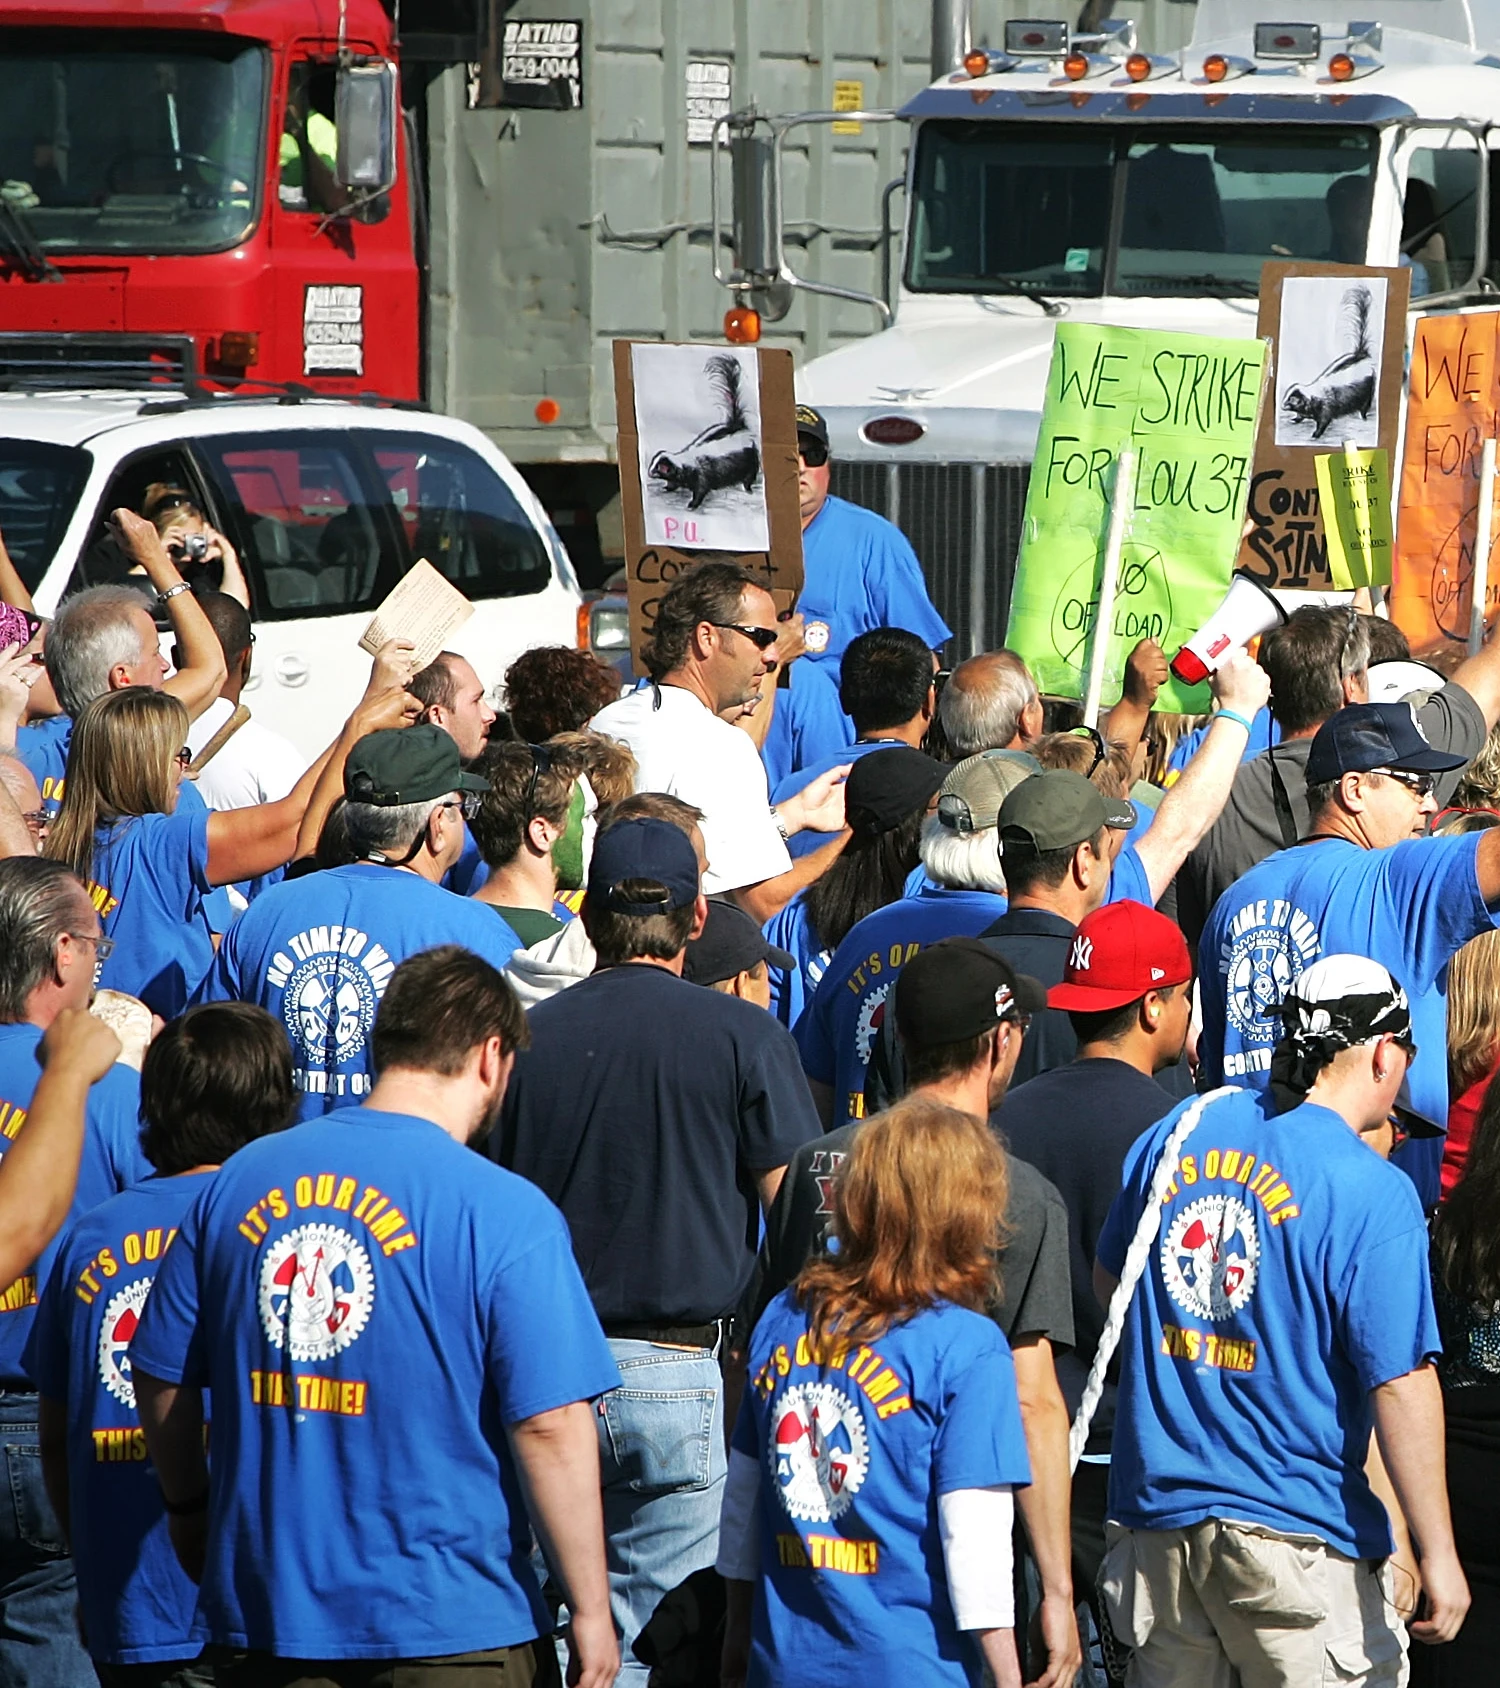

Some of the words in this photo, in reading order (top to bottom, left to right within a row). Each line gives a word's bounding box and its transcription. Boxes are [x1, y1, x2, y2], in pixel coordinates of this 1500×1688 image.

[1422, 327, 1485, 402] WE
[1060, 341, 1128, 409] WE
[1140, 350, 1261, 433] STRIKE
[1423, 424, 1482, 484] FOR
[1045, 436, 1111, 505] FOR
[1133, 447, 1200, 512] LOU
[1204, 453, 1248, 521] 37
[1247, 469, 1321, 527] CONT
[664, 517, 705, 543] P.U.
[1241, 527, 1333, 589] STIN
[1062, 598, 1098, 634] OF
[1113, 611, 1163, 640] LOAD
[86, 880, 118, 919] IME
[1070, 935, 1094, 970] NY
[1228, 900, 1267, 940] TIME
[1270, 900, 1291, 928] TO
[1289, 907, 1322, 961] WAIT
[267, 951, 295, 989] NO
[287, 925, 342, 962] TIME
[341, 927, 368, 958] TO
[361, 943, 396, 999] WAI
[847, 951, 882, 995] IT'S
[1223, 1047, 1272, 1077] CONTR
[1204, 1148, 1257, 1185] OUR
[1250, 1162, 1299, 1226] TIME
[237, 1187, 291, 1246] IT'S
[294, 1173, 358, 1212] OUR
[352, 1185, 418, 1257] TIME
[75, 1247, 118, 1305] IT'S
[123, 1229, 176, 1265] OU
[1226, 1270, 1239, 1288] M
[0, 1275, 38, 1314] IME!
[124, 1286, 150, 1304] UNIO
[295, 1374, 368, 1417] TIME!
[847, 1345, 912, 1421] TIME
[92, 1429, 147, 1462] THIS
[778, 1458, 790, 1477] A
[807, 1534, 878, 1574] TIME!
